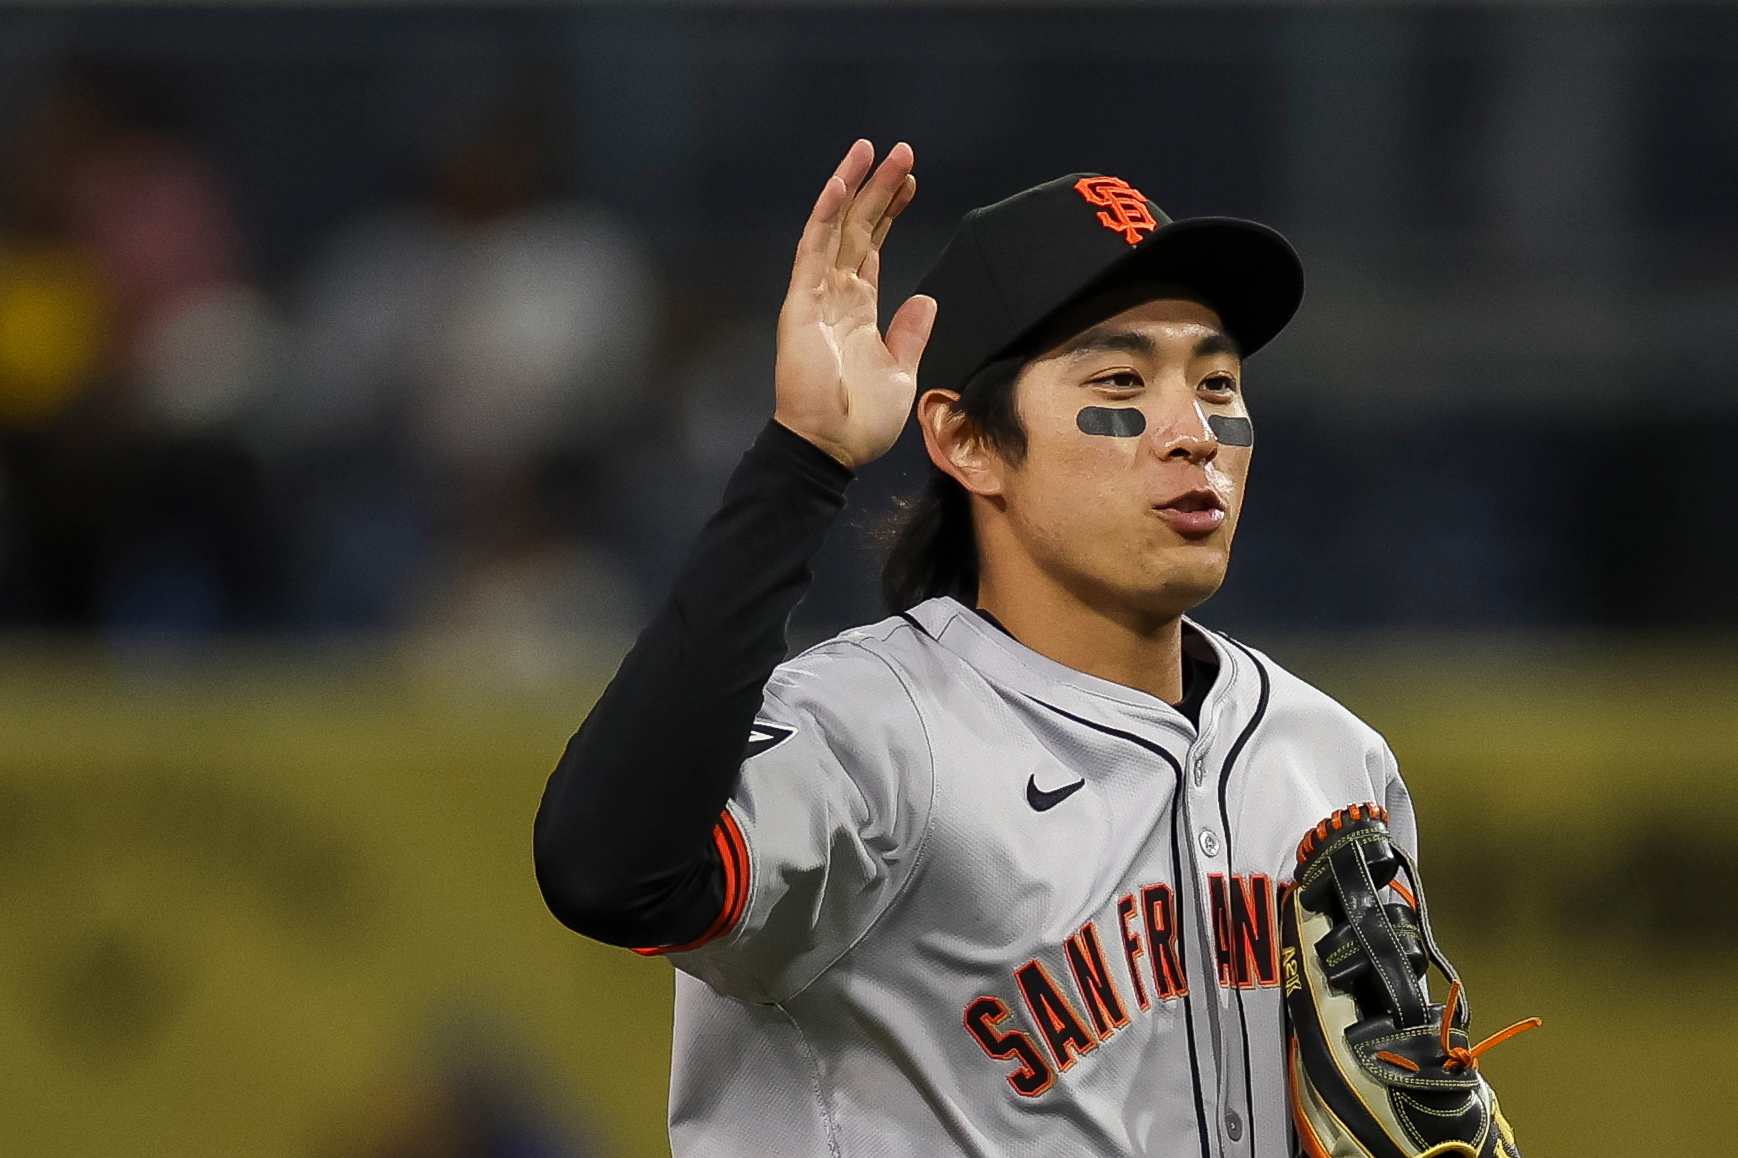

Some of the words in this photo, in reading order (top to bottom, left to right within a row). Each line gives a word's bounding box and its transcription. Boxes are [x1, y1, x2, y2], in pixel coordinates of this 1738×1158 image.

[962, 918, 1132, 1099] SAN
[1114, 872, 1290, 1013] FRAN
[1281, 945, 1302, 999] A2K
